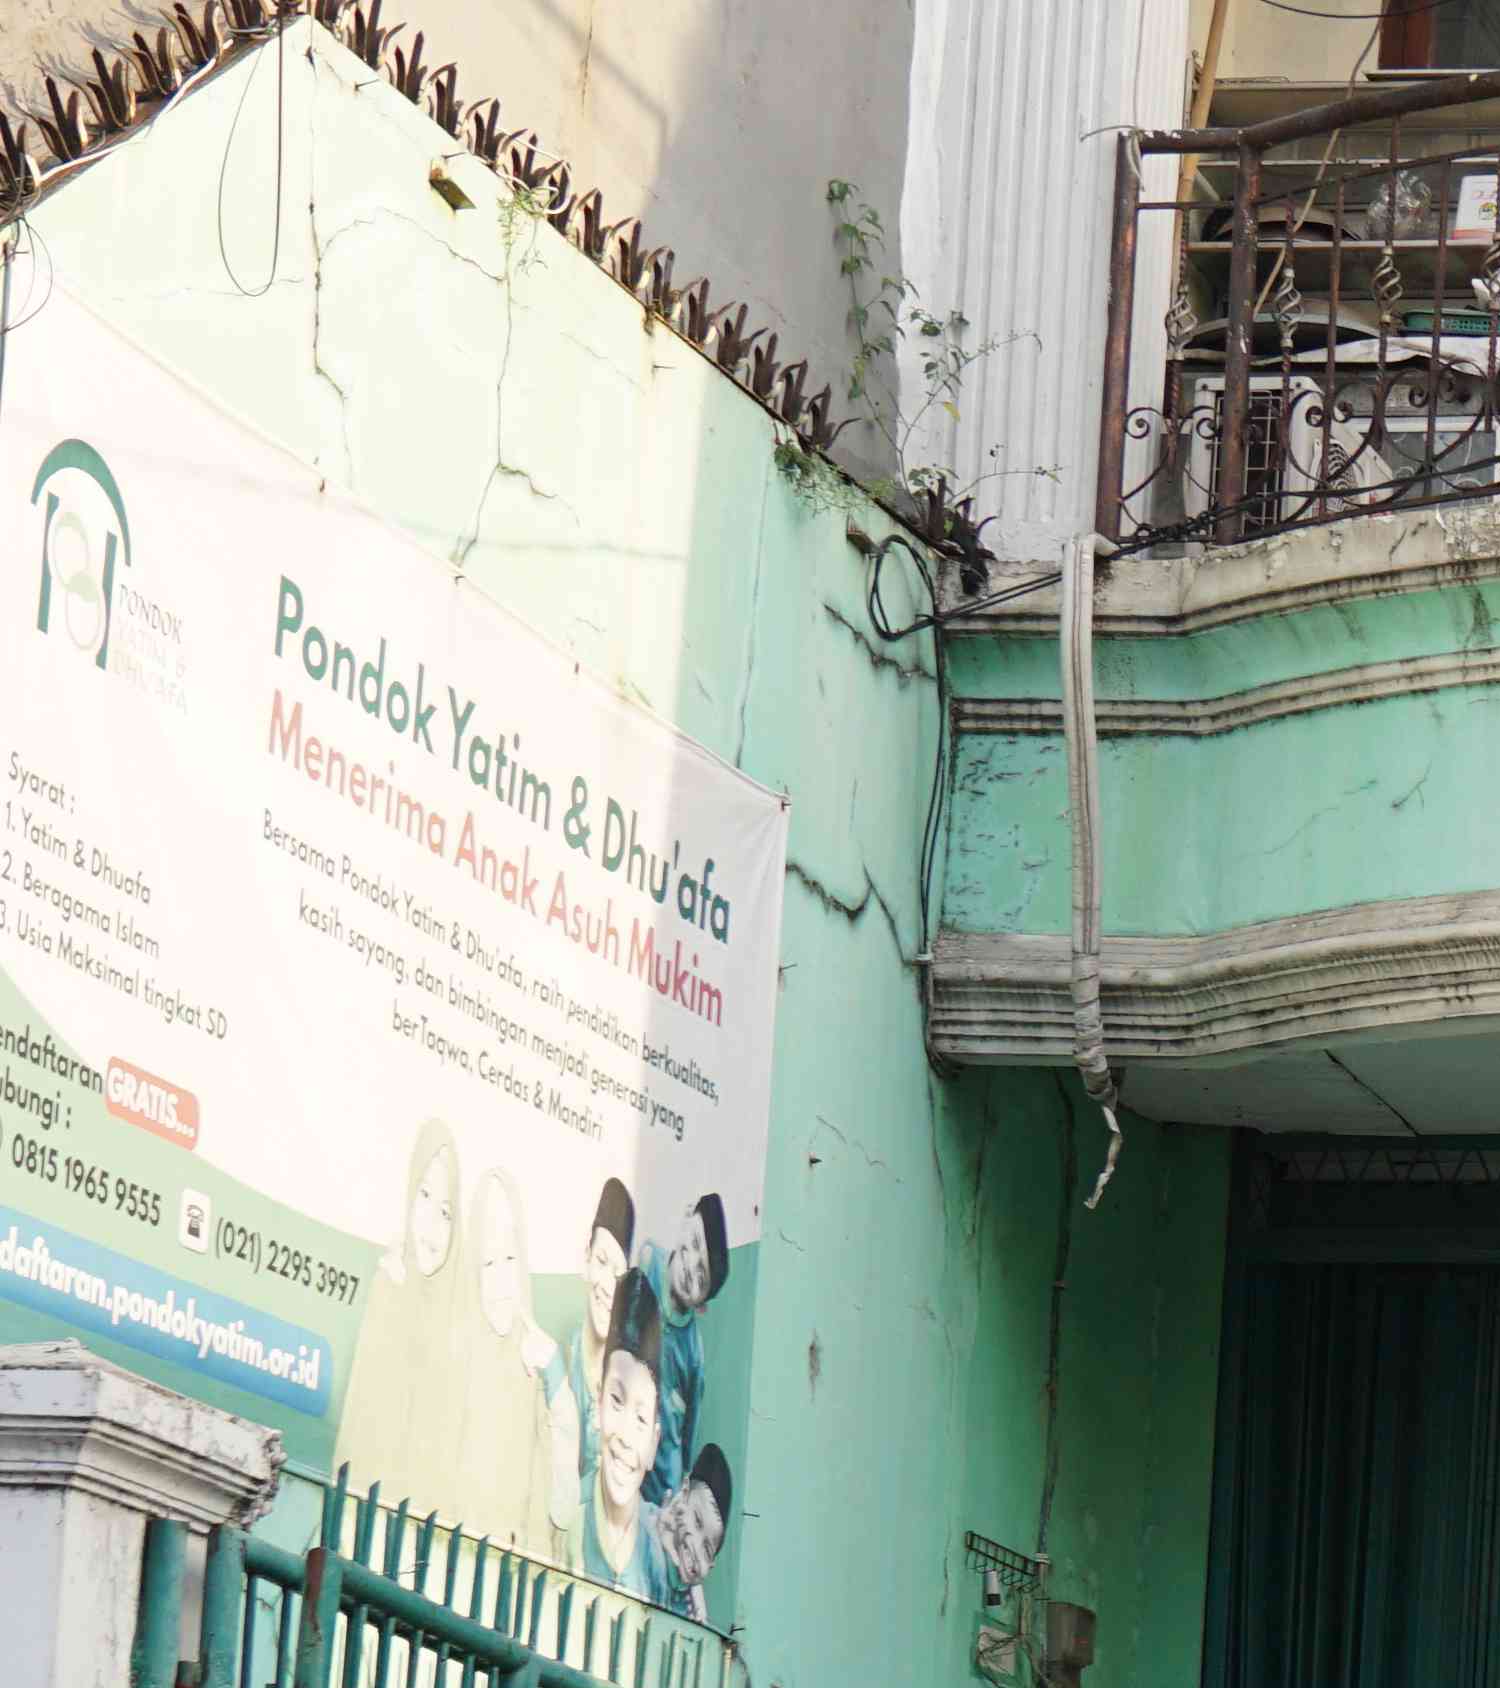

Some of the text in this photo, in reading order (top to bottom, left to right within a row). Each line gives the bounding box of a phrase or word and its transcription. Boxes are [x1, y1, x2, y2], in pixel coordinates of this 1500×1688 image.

[8, 751, 67, 812] Syarat
[274, 574, 731, 944] Pondok Yatim & Dhu'afa
[1, 850, 161, 960] 2. Beragama Islam
[4, 800, 153, 905] 1. Yatim & Dhuafa
[267, 688, 723, 1027] Menerima Anak Asuh Mukim
[16, 907, 54, 955] Usia
[57, 930, 140, 999] Maksimal
[143, 977, 203, 1030] tingkat
[205, 1003, 229, 1041] SD
[263, 808, 336, 878] Bersama
[341, 854, 400, 917] Pondok
[403, 890, 447, 945] Yatim
[450, 922, 462, 954] &
[532, 976, 565, 1011] raih
[567, 998, 640, 1057] pendidikan
[641, 1031, 720, 1107] berkualitas,
[298, 887, 685, 1142] kasih sayang, dan bimbingan menjadi generasi yang
[478, 1050, 529, 1103] Cerdas
[532, 1080, 545, 1111] &
[547, 1086, 604, 1141] Mandiri
[12, 1132, 361, 1306] 0815 1965 9555 (021) 2295 3997
